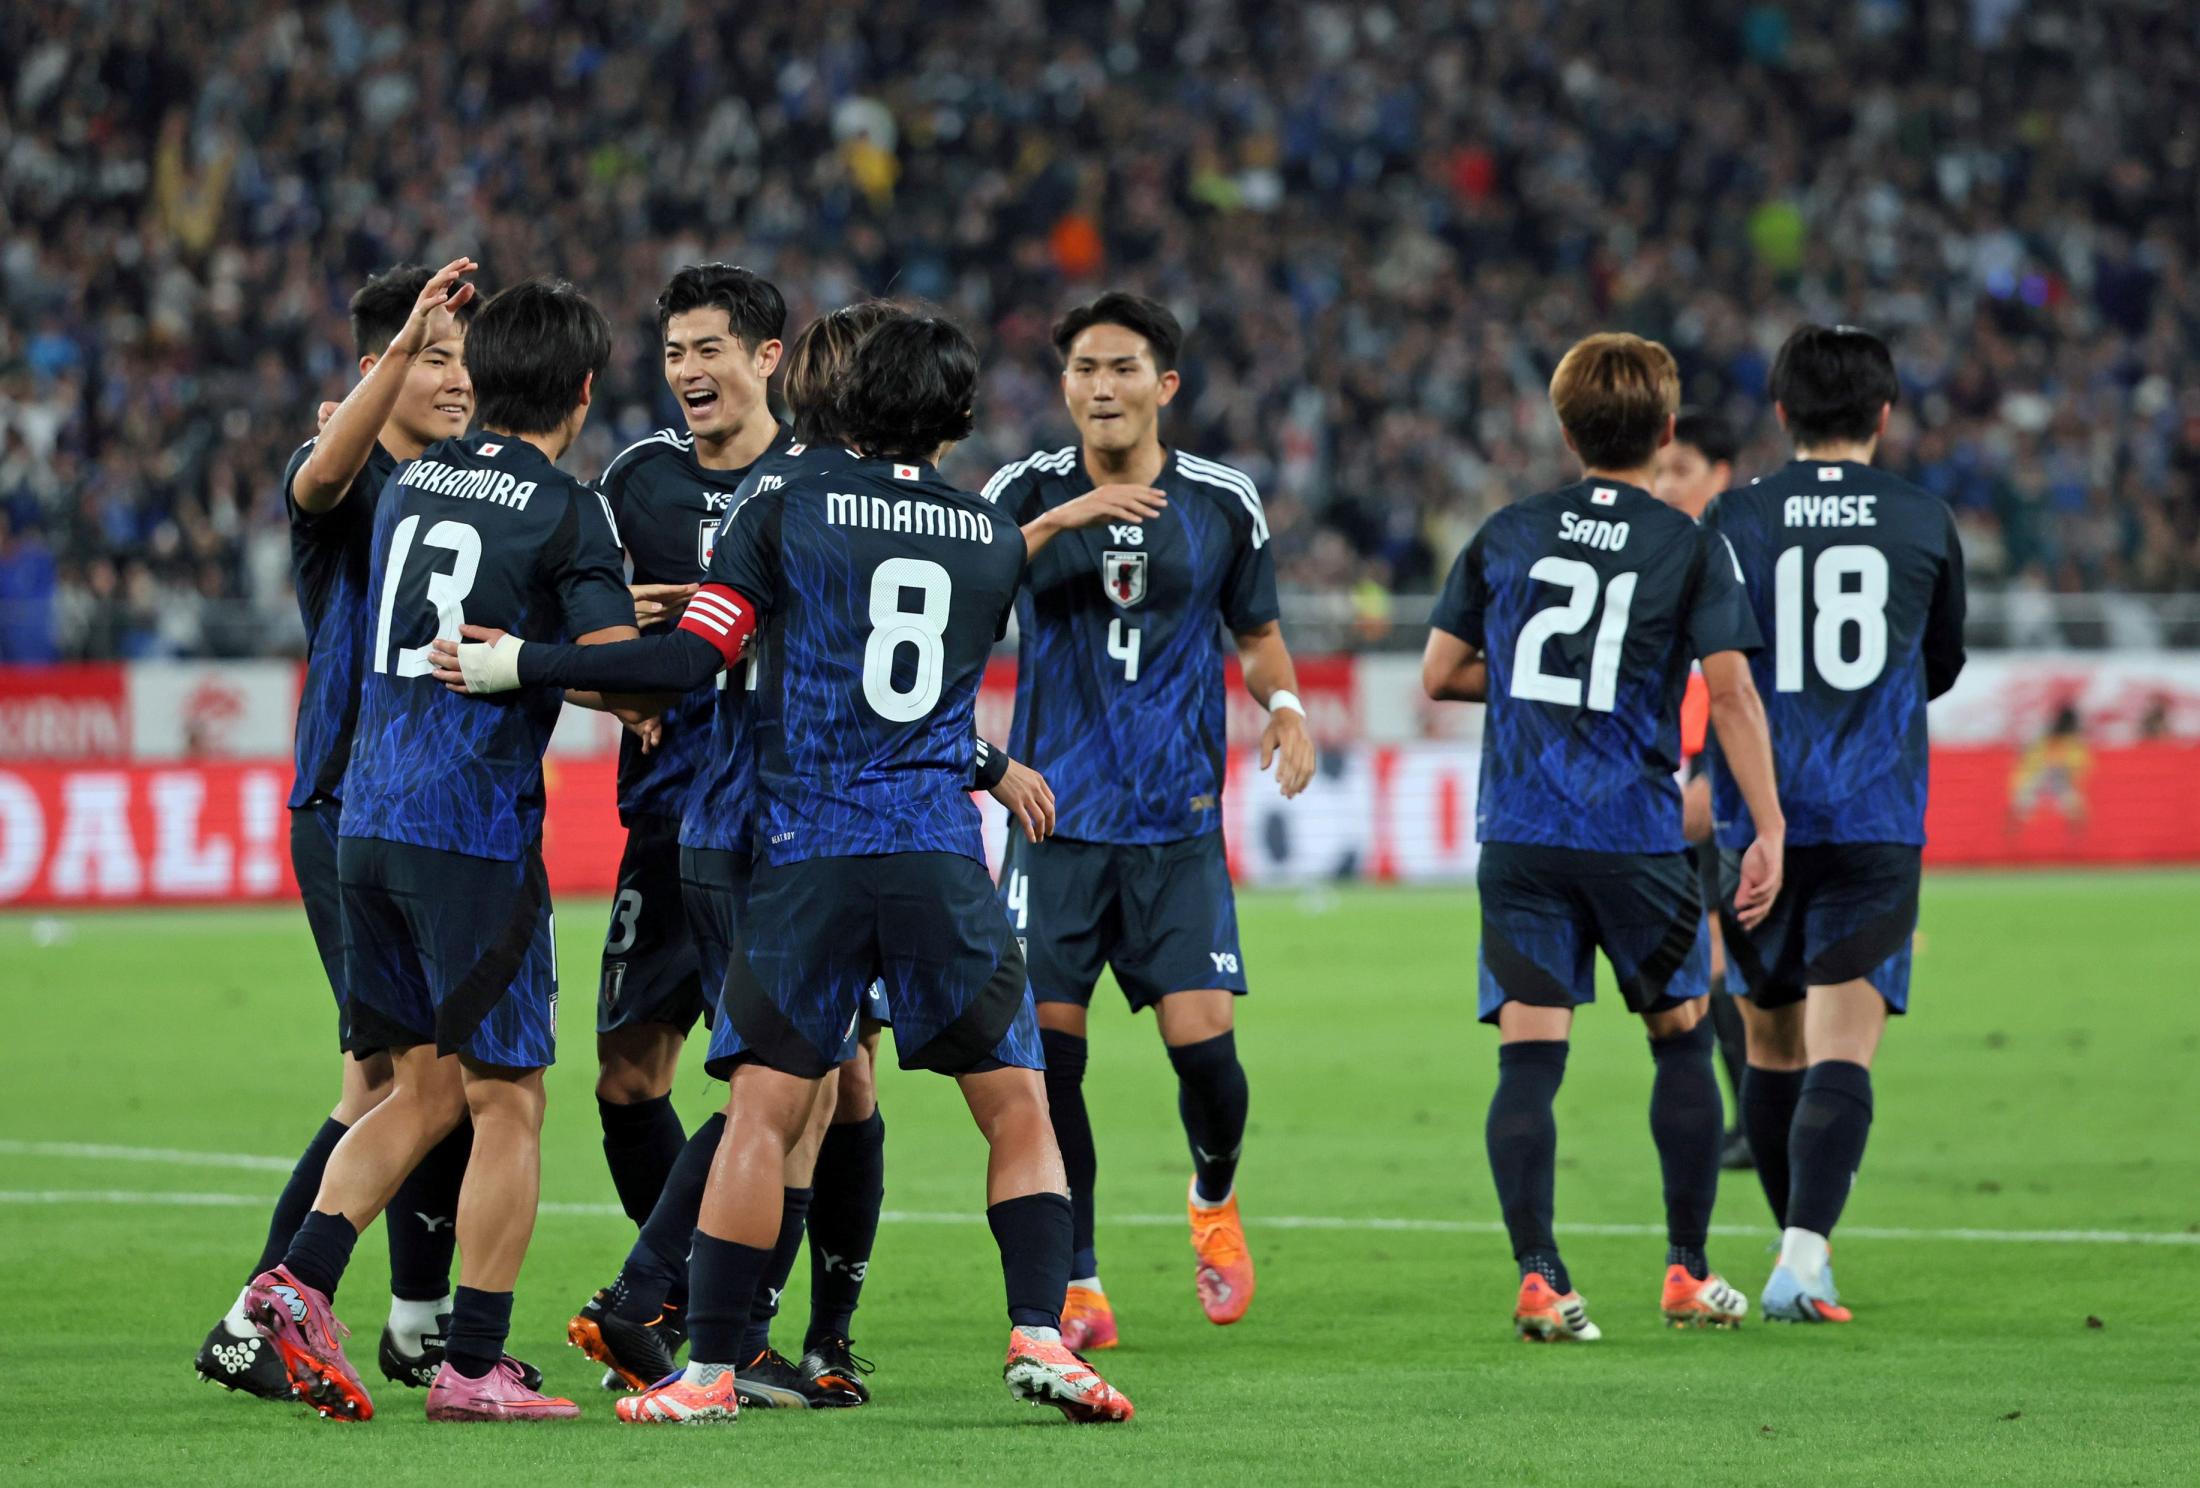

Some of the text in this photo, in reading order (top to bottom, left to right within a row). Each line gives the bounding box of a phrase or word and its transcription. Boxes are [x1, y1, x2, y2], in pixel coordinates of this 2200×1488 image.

[397, 459, 538, 511] NAKAMURA
[1784, 495, 1877, 527] AYASE
[826, 492, 993, 545] MINAMINO
[1108, 524, 1144, 545] Y-3
[1558, 511, 1630, 551] SANO
[374, 514, 482, 678] 13
[1775, 545, 1889, 693] 18
[863, 557, 952, 723] 8
[1107, 617, 1141, 682] 4
[1510, 556, 1639, 713] 21
[606, 888, 643, 955] 3
[1007, 867, 1029, 930] 4
[1209, 952, 1239, 974] Y-3
[820, 1246, 868, 1282] Y-3
